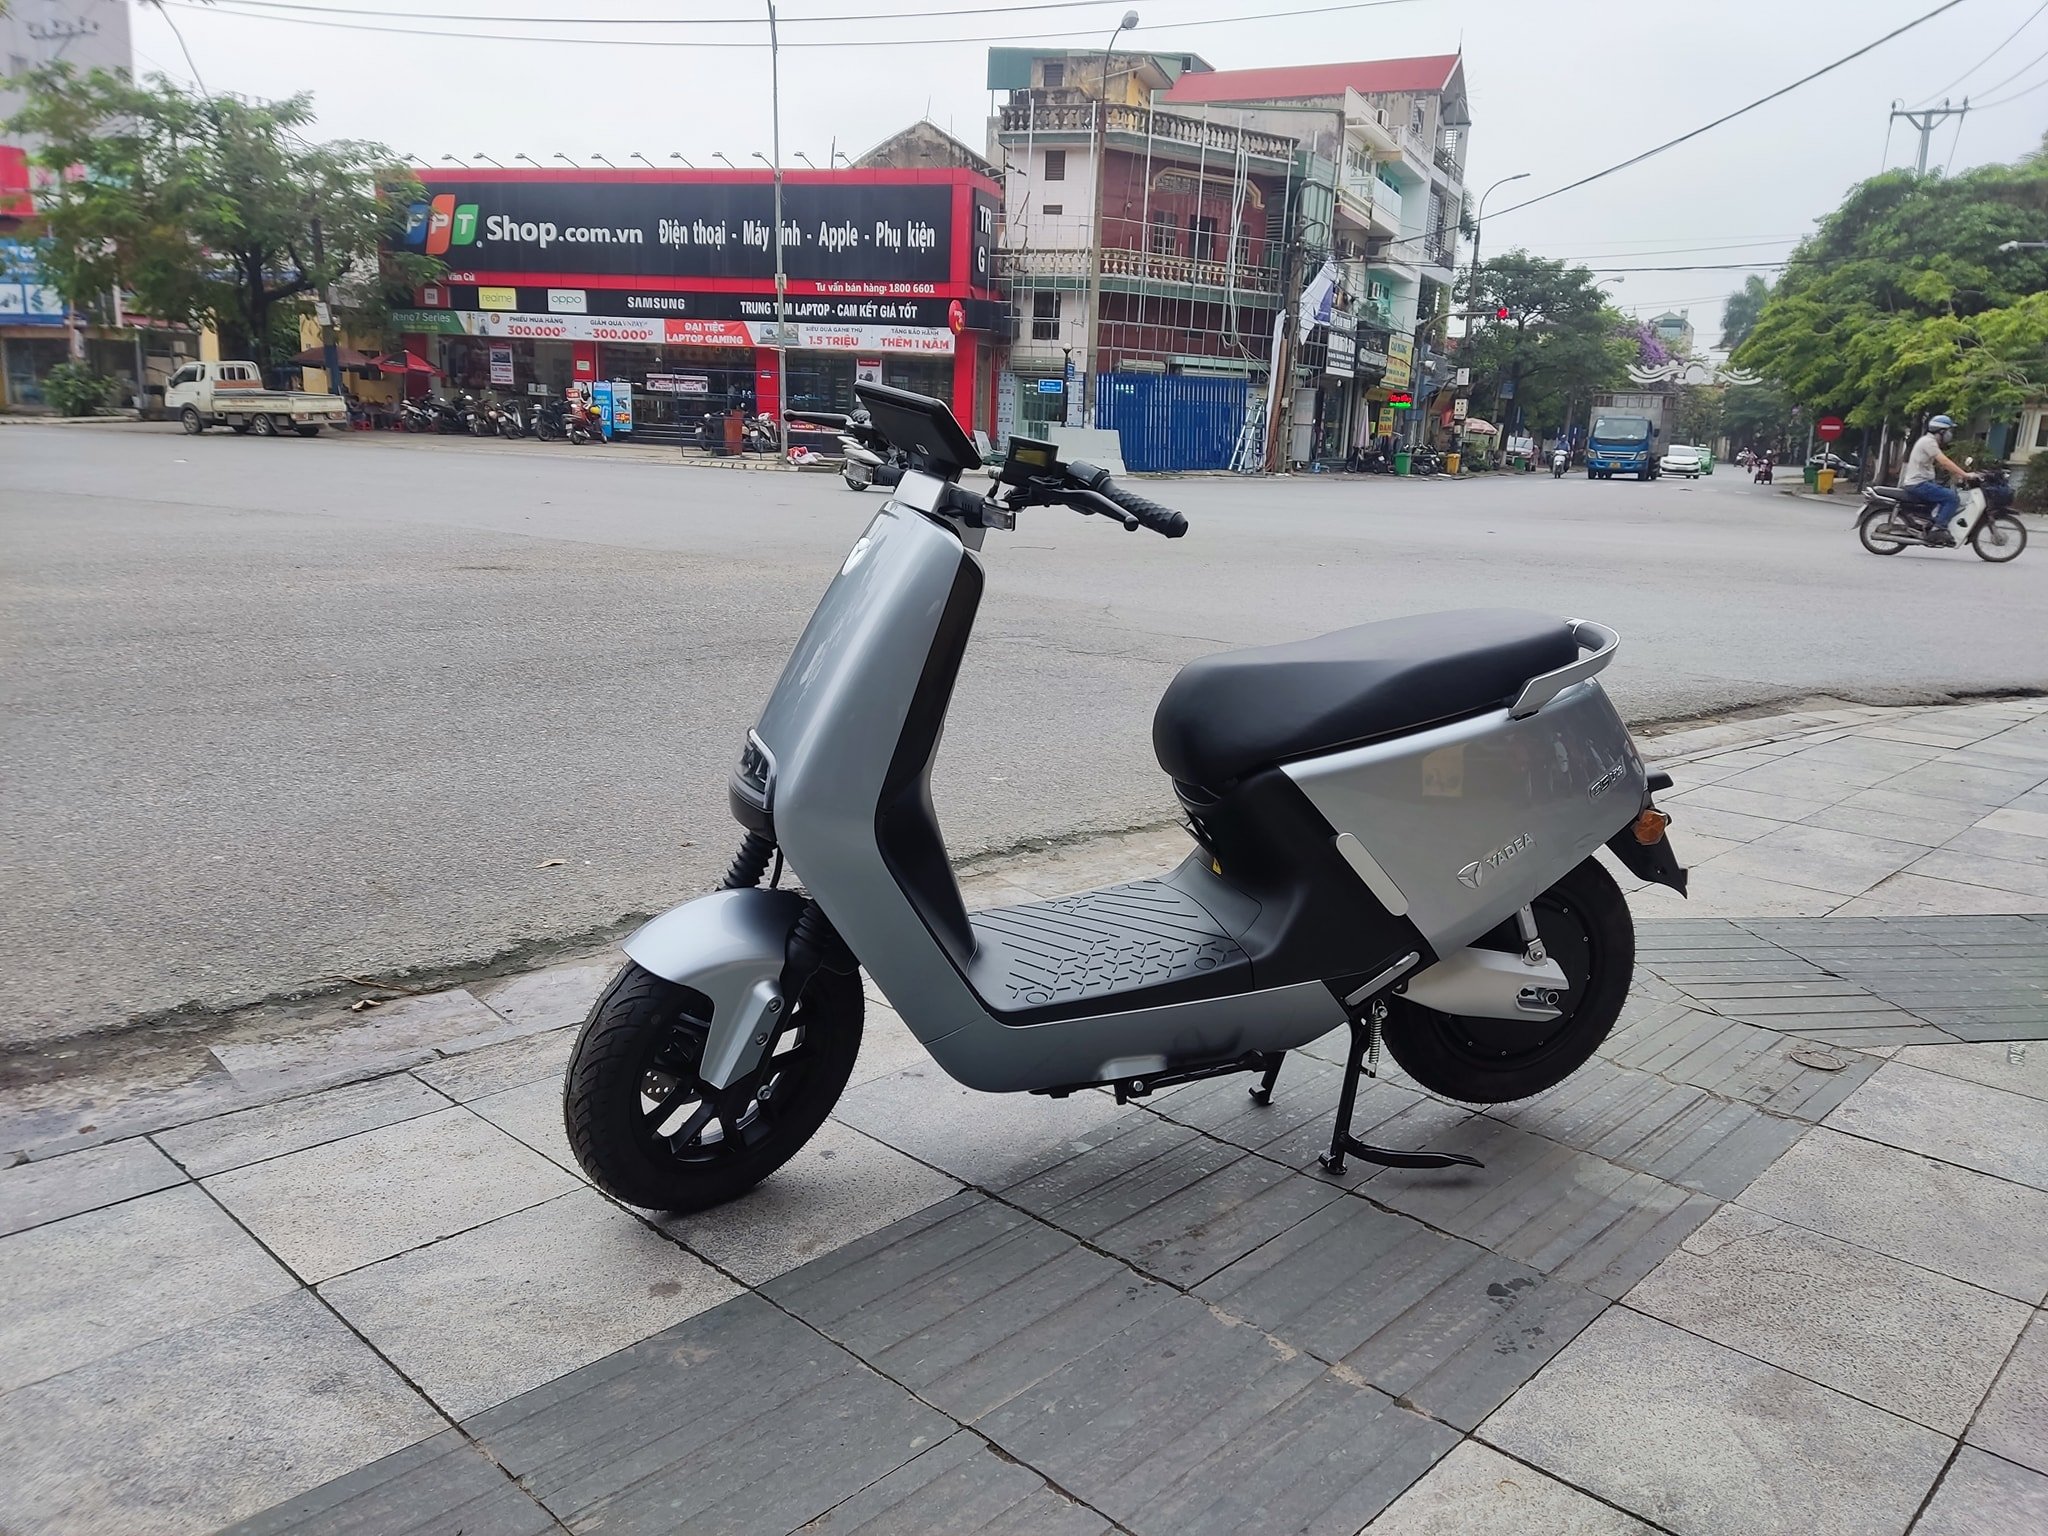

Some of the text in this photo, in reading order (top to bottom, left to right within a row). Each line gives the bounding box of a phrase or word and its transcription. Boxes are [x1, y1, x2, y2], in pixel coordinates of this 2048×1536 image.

[979, 204, 992, 234] TR
[486, 215, 643, 249] Shop.com.vn
[658, 218, 935, 254] Điện thoại Máy ính Apple Phụ kiện
[978, 246, 986, 273] G
[815, 281, 935, 295] Tư vấn bán hàng: 1800 6601
[482, 294, 513, 303] realme
[551, 295, 582, 305] oppo
[627, 296, 686, 310] SAMSUNG
[740, 301, 771, 315] TRUNG
[795, 303, 830, 317] LAPTOP
[837, 304, 857, 317] CAM
[859, 301, 878, 318] KẾT
[879, 302, 896, 318] GIÁ
[899, 301, 918, 319] TỐT
[422, 313, 451, 323] Series
[684, 320, 725, 334] ĐẠI TIỆC
[666, 333, 744, 344] LAPTOP GAMING
[808, 334, 859, 349] 1.5 TRIỆU
[880, 336, 912, 348] THÊM
[922, 337, 949, 350] NĂM
[1485, 833, 1535, 870] YADEA
